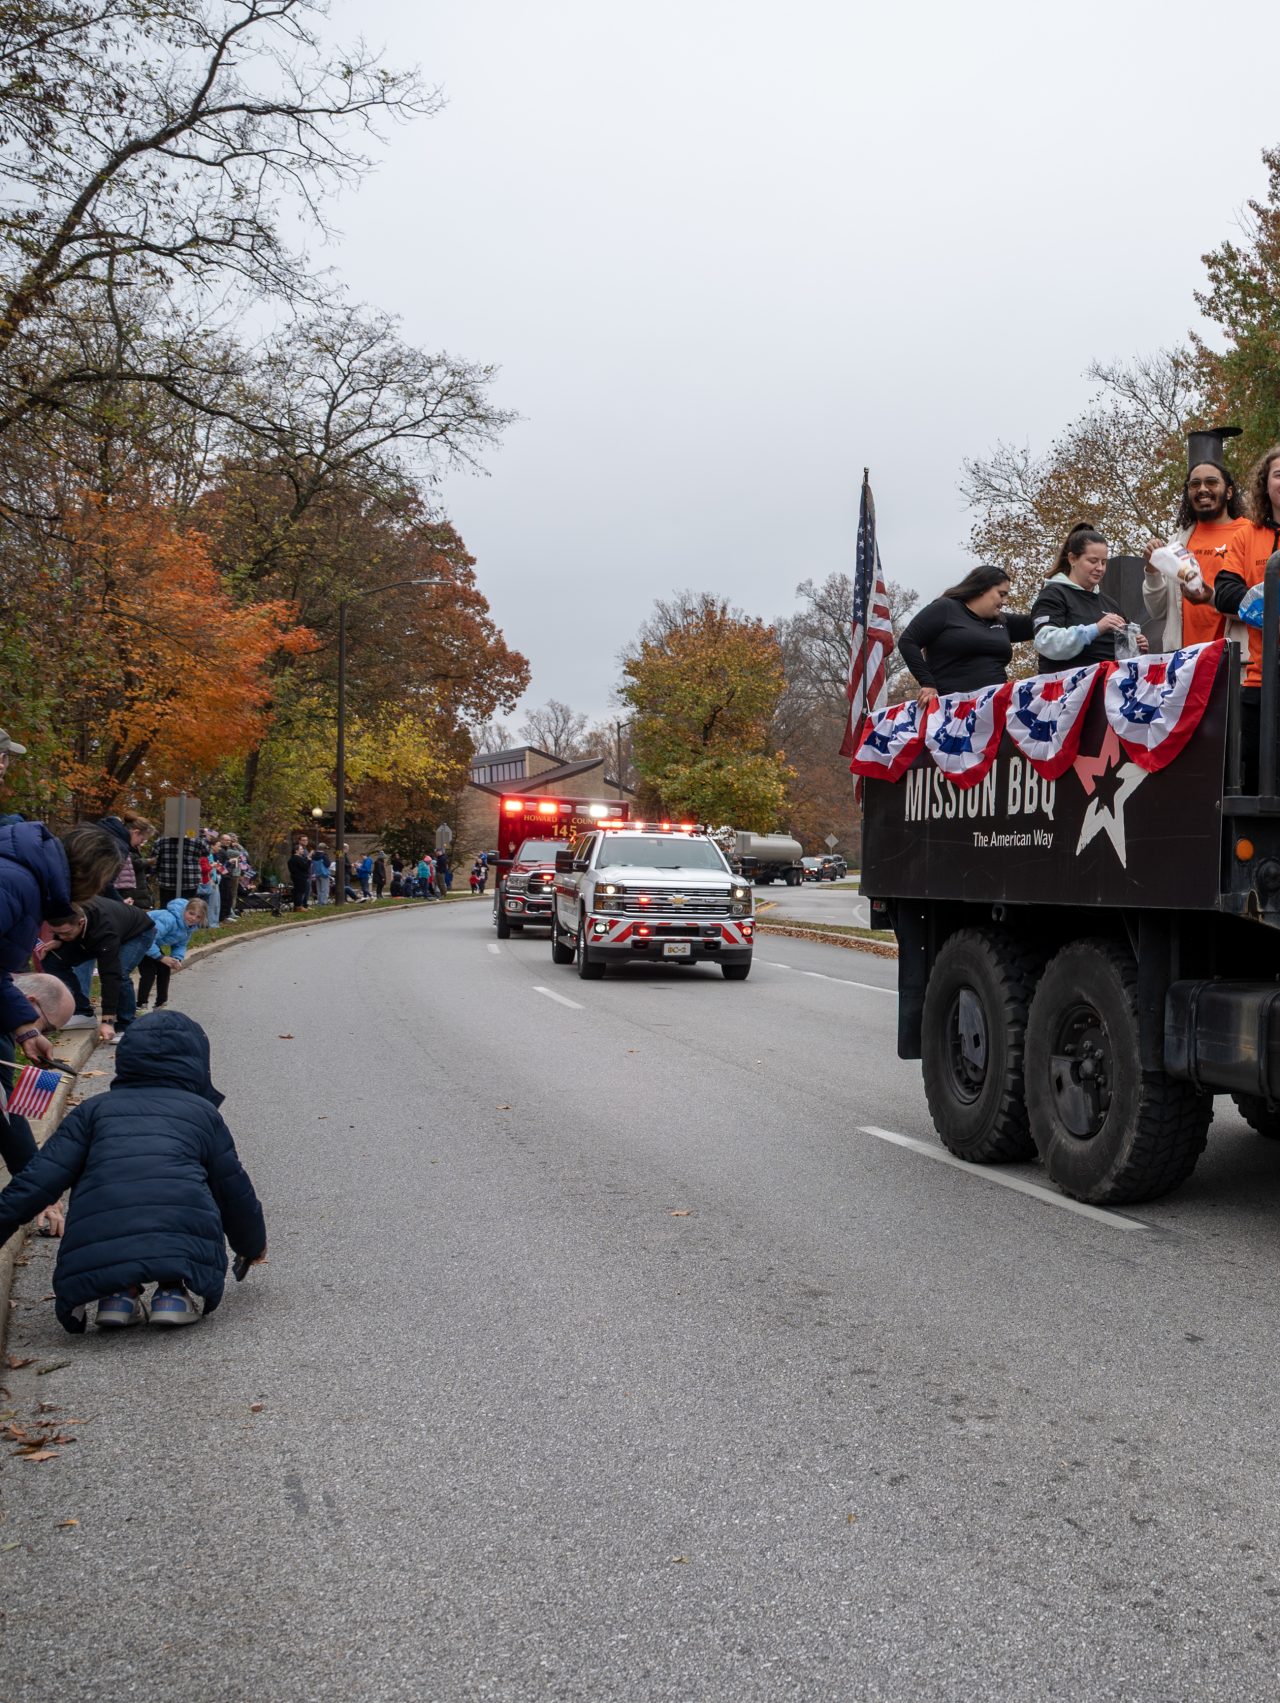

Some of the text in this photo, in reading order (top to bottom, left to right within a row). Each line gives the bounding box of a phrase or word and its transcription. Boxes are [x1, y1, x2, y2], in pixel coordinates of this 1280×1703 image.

[904, 756, 1056, 822] MISSION BBQ
[523, 814, 558, 823] HOWARD
[571, 816, 598, 825] COUNT
[551, 824, 577, 838] 145
[973, 829, 1054, 849] The American Way
